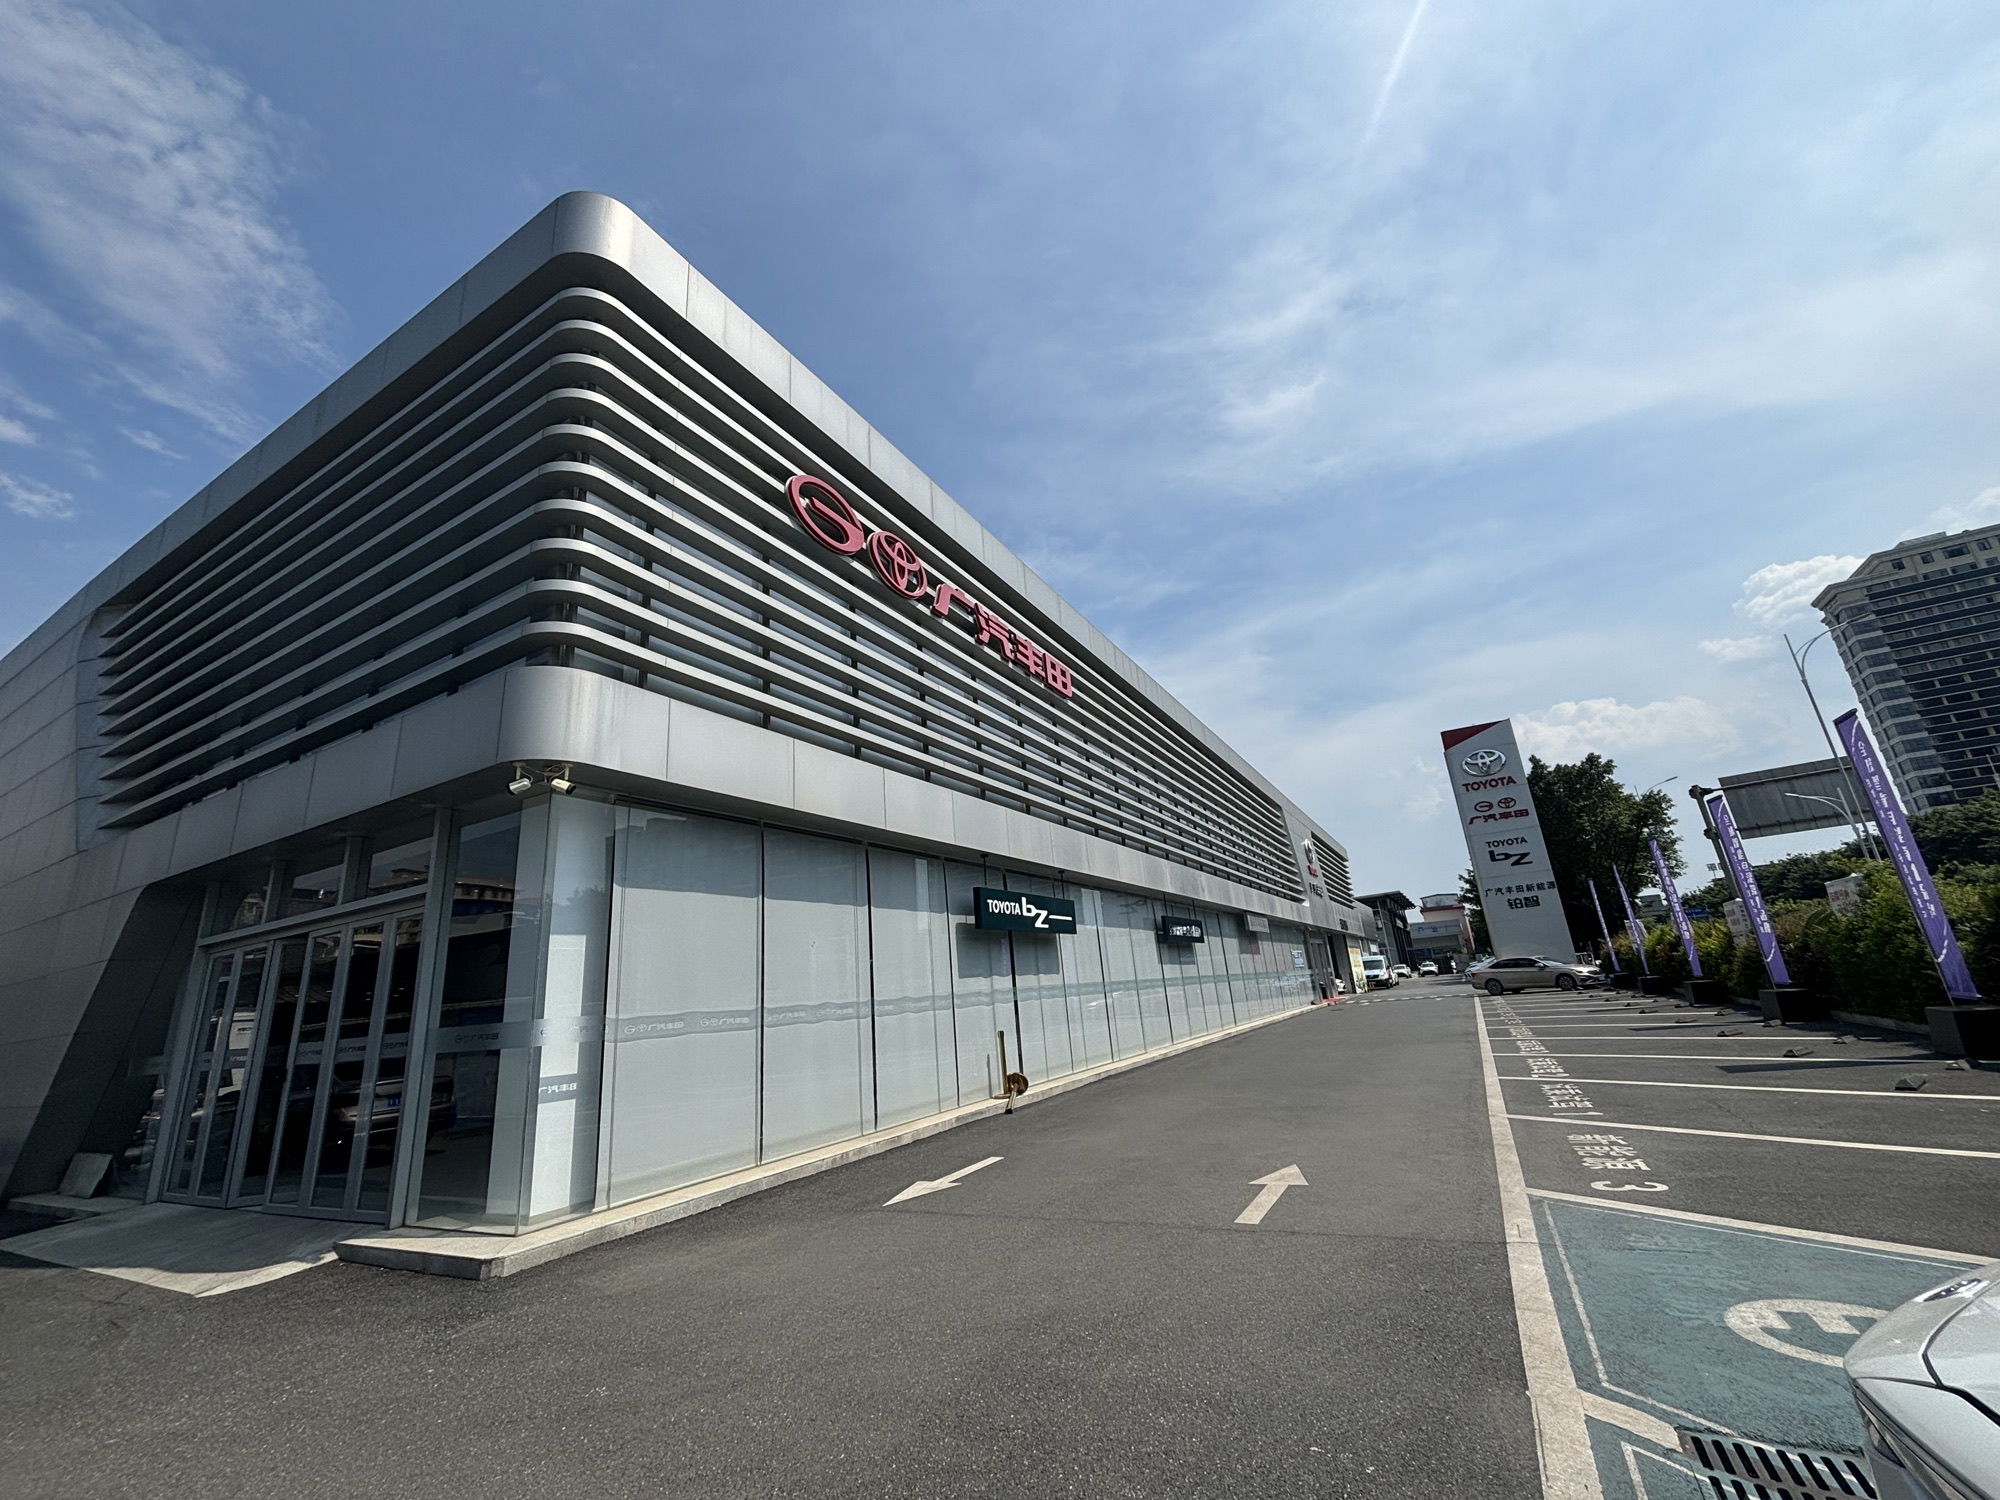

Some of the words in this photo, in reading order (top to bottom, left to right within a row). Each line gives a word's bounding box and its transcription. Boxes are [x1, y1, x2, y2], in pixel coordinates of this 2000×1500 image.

[930, 583, 1072, 698] 广汽丰田
[1462, 776, 1517, 792] TOYOTA
[1468, 809, 1529, 825] 广汽丰田
[1486, 837, 1528, 848] TOYOTA
[1485, 881, 1557, 897] 广汽丰田新能源
[987, 899, 1021, 916] TOYOTA
[1507, 896, 1540, 909] 铂智
[1566, 1133, 1651, 1170] 新能源
[1590, 1180, 1669, 1192] 3
